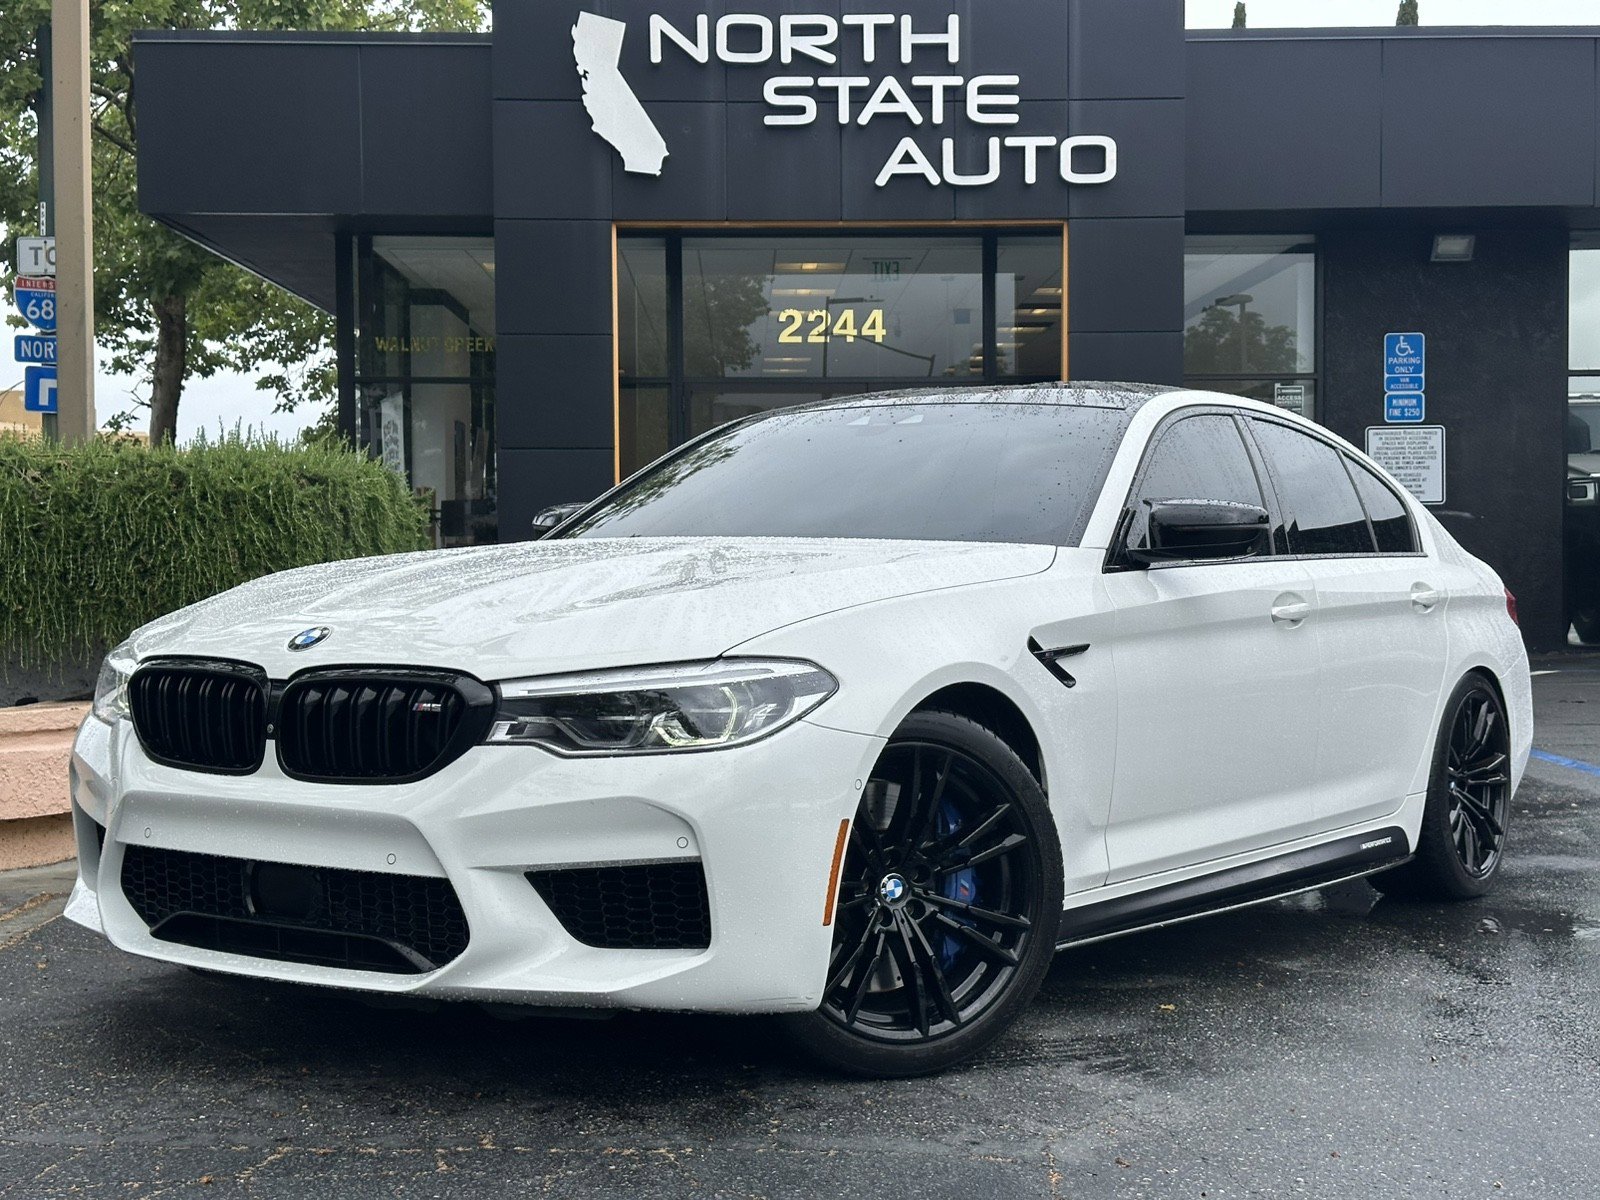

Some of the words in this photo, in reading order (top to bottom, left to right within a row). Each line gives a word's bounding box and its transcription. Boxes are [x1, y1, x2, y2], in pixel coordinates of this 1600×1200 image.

[649, 14, 960, 64] NORTH
[763, 74, 1020, 126] STATE
[874, 135, 1118, 187] AUTO
[21, 281, 54, 290] INTERS
[26, 299, 55, 320] 68
[778, 308, 886, 343] 2244
[21, 340, 56, 359] NOR
[1388, 357, 1421, 365] PARKING
[1389, 408, 1401, 416] FINE
[1404, 408, 1420, 416] $250
[1392, 398, 1417, 406] MINIMUM
